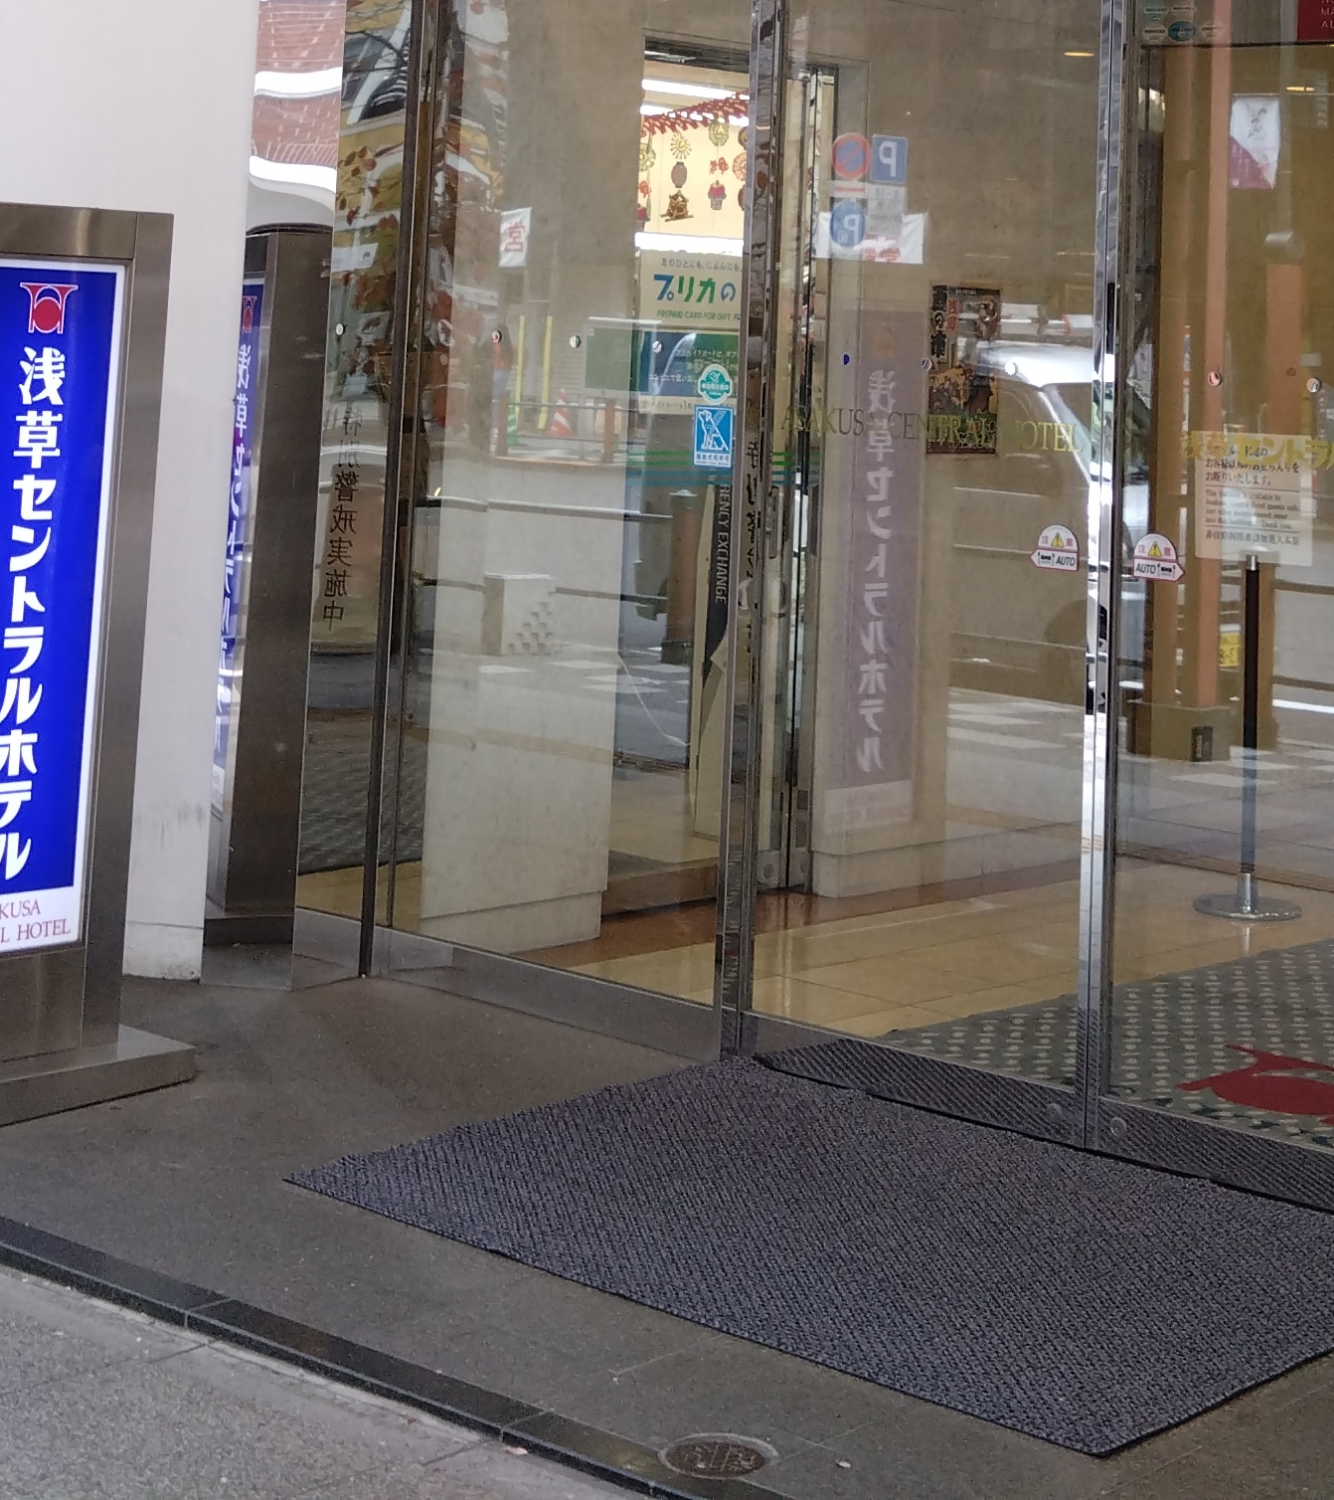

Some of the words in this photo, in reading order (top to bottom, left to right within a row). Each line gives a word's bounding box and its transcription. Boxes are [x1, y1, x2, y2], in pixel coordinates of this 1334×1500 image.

[1008, 419, 1081, 453] OTEL
[716, 533, 729, 604] EXCHANGE
[1055, 556, 1076, 567] AUTO
[1136, 563, 1157, 575] AUTO
[16, 918, 72, 942] HOTEL
